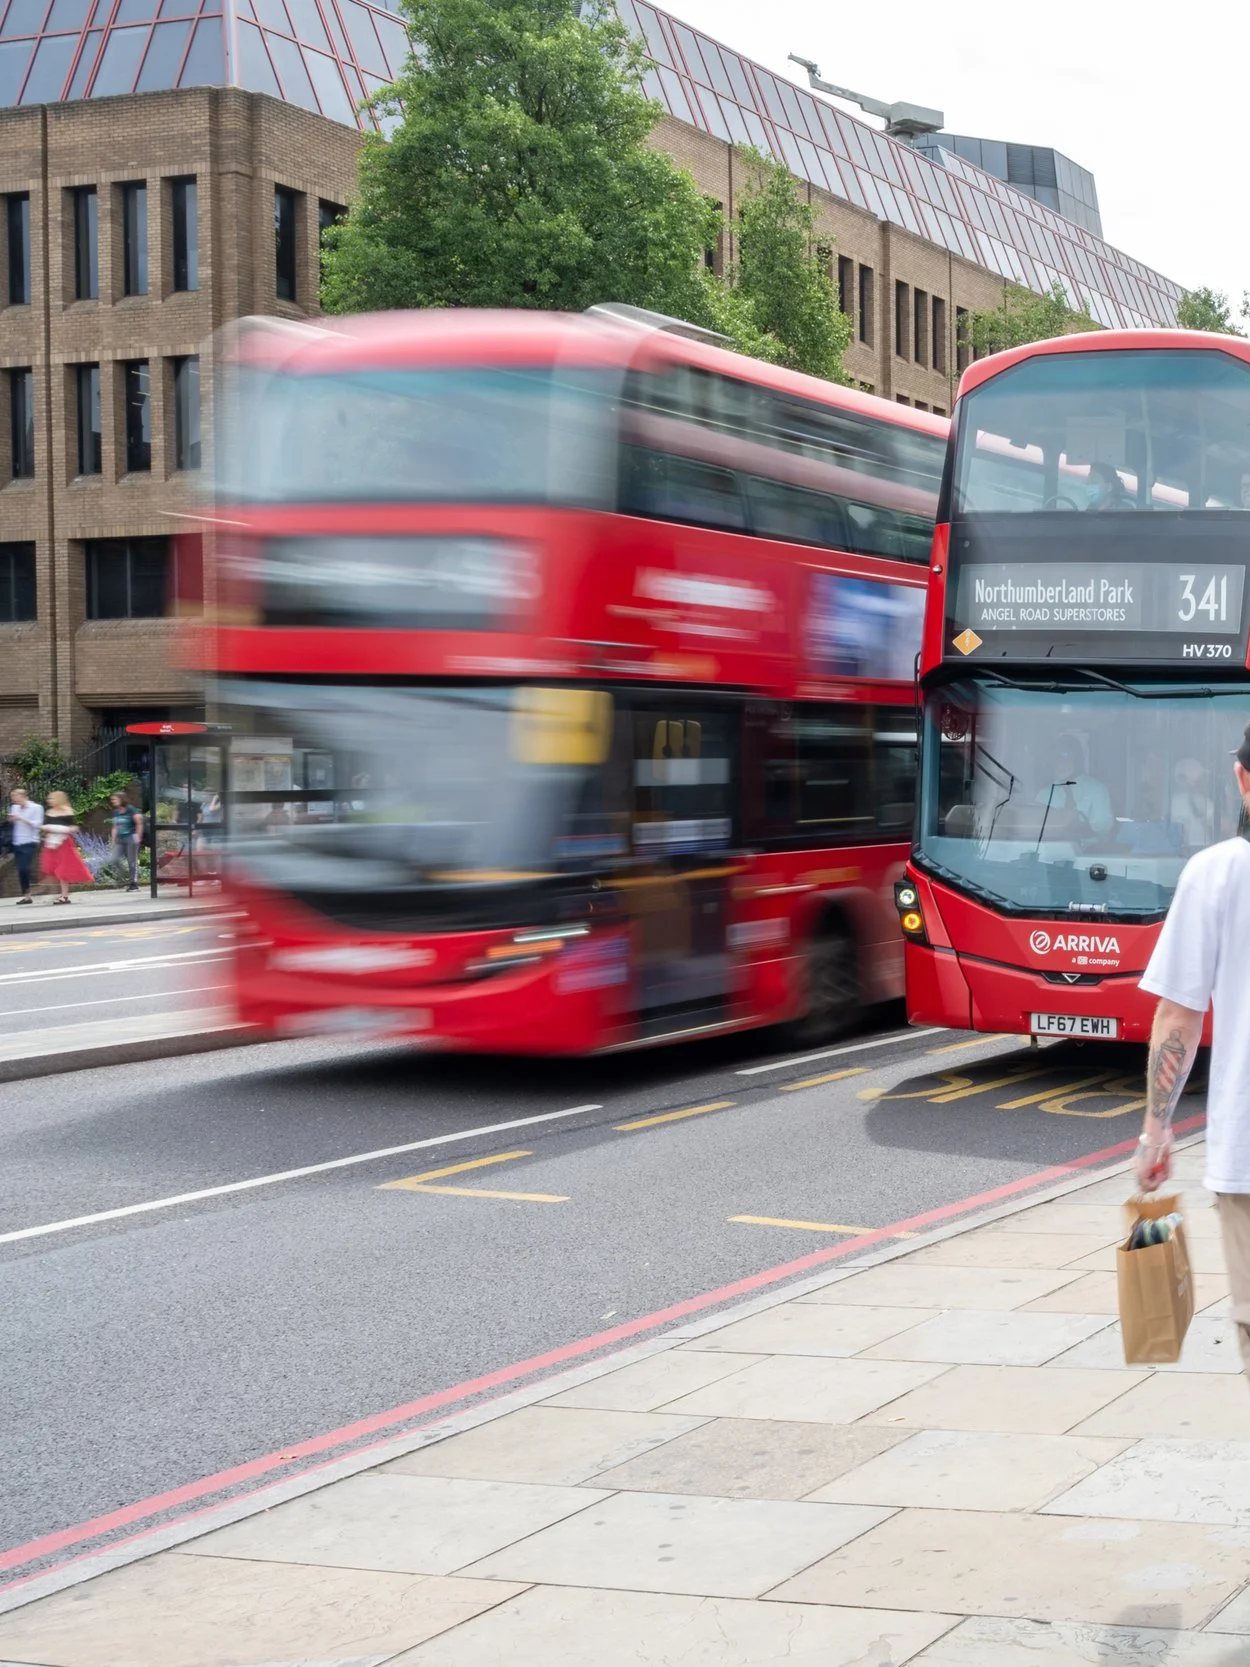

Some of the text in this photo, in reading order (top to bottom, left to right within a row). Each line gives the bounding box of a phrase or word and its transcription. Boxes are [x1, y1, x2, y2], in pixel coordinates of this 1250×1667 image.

[975, 578, 1133, 604] Northumberland Park
[1178, 574, 1228, 621] 341
[981, 608, 1126, 622] ANGEL ROAD SUPERSTORES
[1182, 643, 1232, 658] HV 370
[1053, 935, 1120, 954] ARRIVA
[1089, 958, 1120, 967] company
[1037, 1014, 1110, 1034] LF67 EWH
